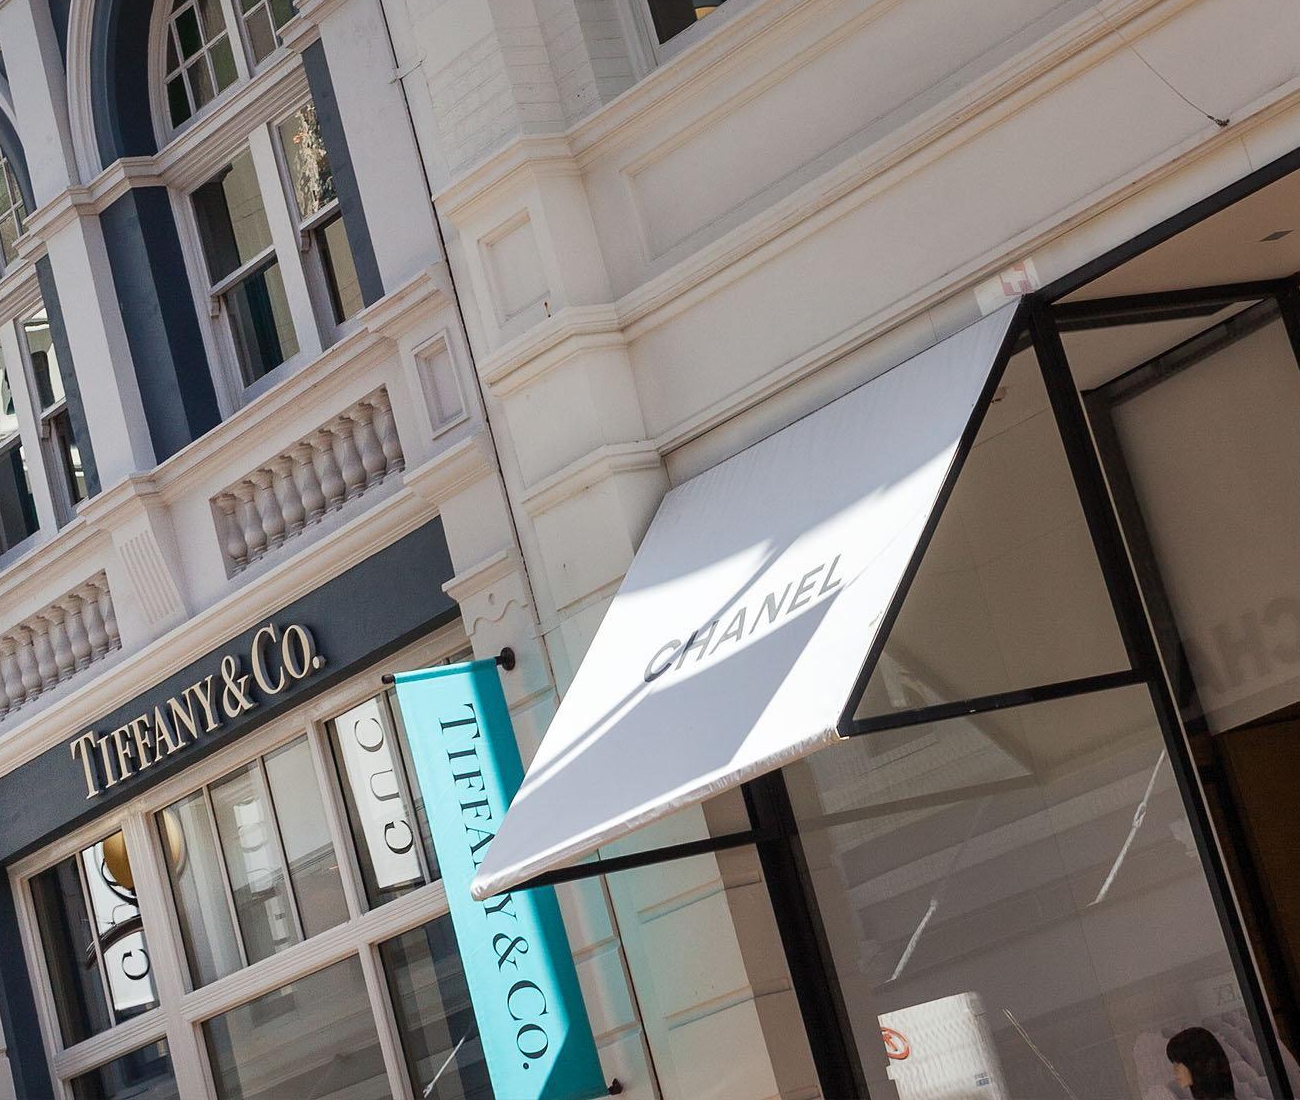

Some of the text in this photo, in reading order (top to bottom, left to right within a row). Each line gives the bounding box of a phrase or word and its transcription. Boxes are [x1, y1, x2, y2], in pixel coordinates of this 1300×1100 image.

[643, 553, 843, 682] CHANEL
[439, 703, 549, 1070] TIFFAY & CO.
